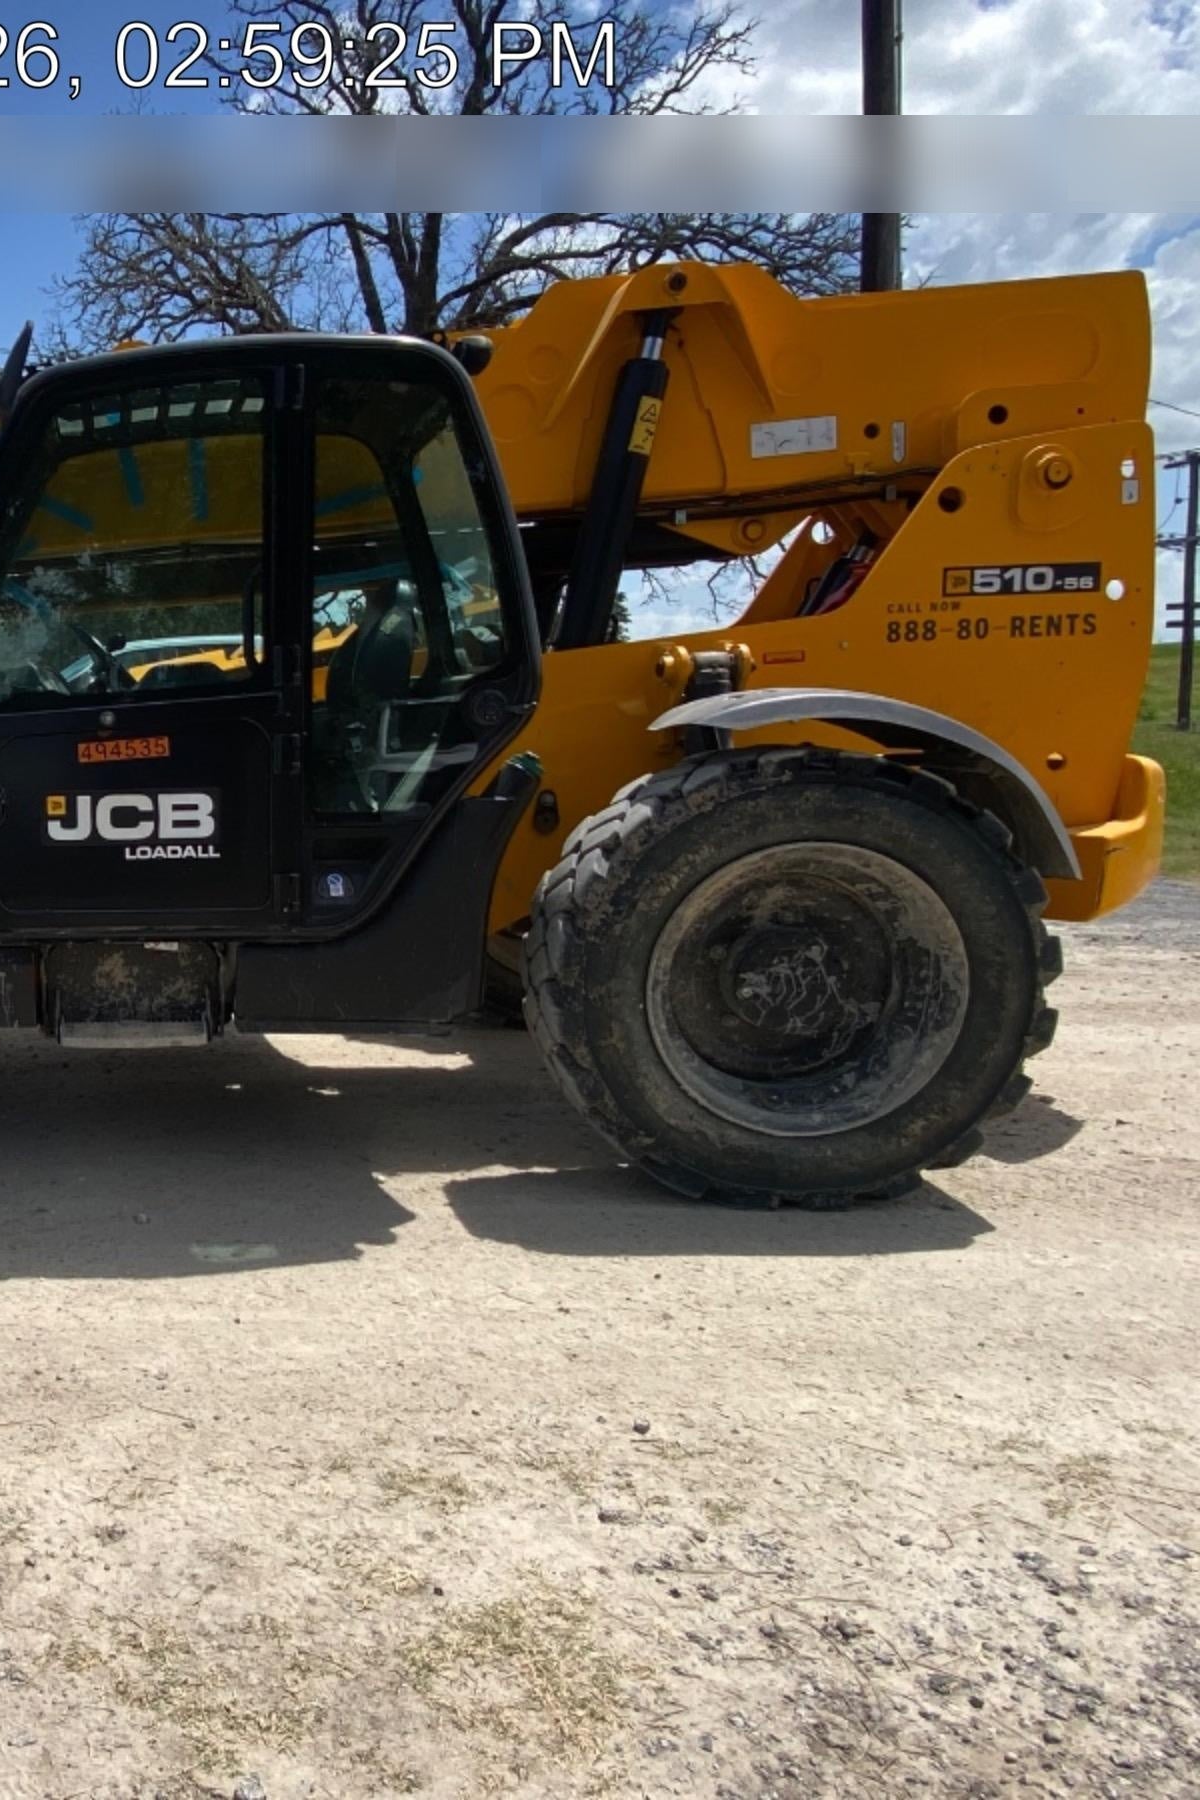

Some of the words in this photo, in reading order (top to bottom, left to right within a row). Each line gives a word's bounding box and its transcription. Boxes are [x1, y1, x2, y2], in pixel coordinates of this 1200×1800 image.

[887, 602, 922, 614] CALL
[929, 600, 961, 612] NOW
[81, 737, 167, 761] 494535
[46, 793, 216, 841] JCB
[125, 845, 221, 860] LOADALL
